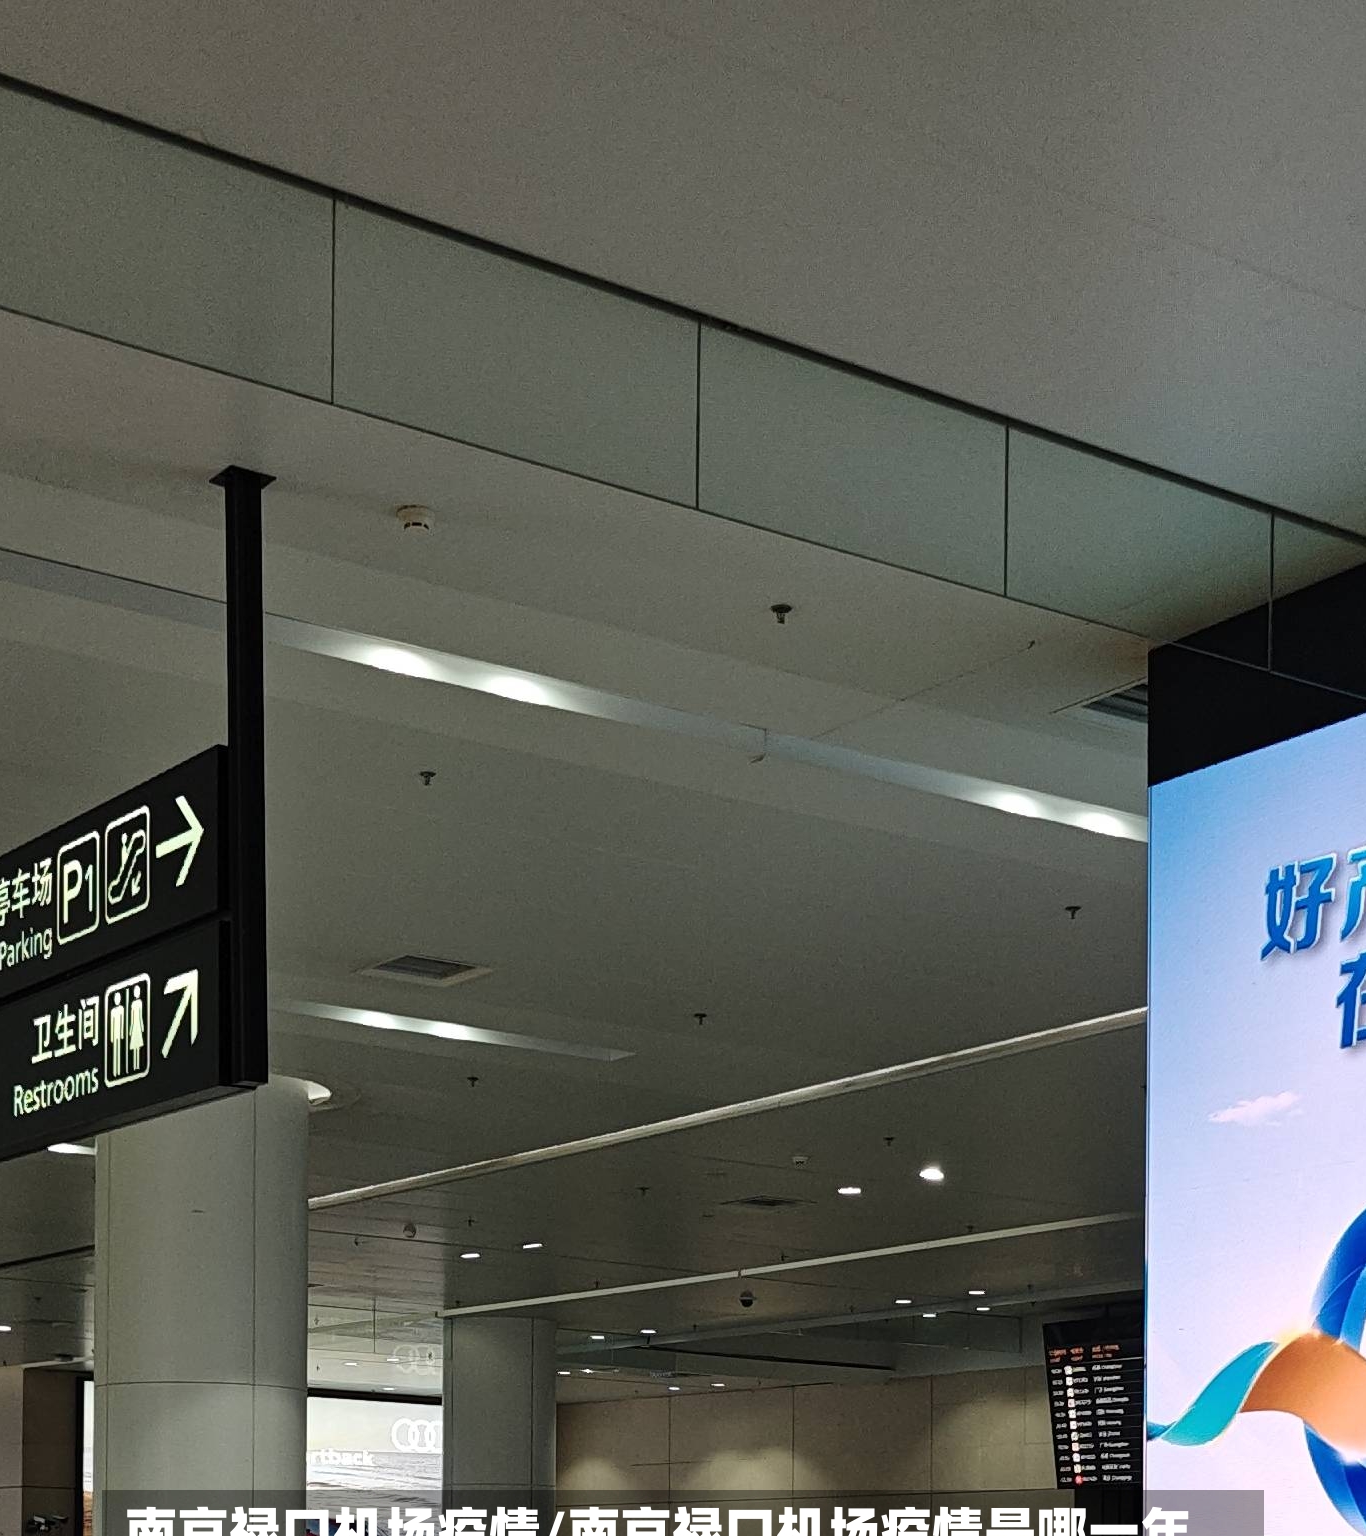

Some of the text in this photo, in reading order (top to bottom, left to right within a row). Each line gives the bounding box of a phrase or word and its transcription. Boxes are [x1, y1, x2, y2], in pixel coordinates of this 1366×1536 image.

[63, 859, 94, 924] P1
[31, 996, 99, 1064] 卫生间
[13, 1067, 99, 1117] Restrooms
